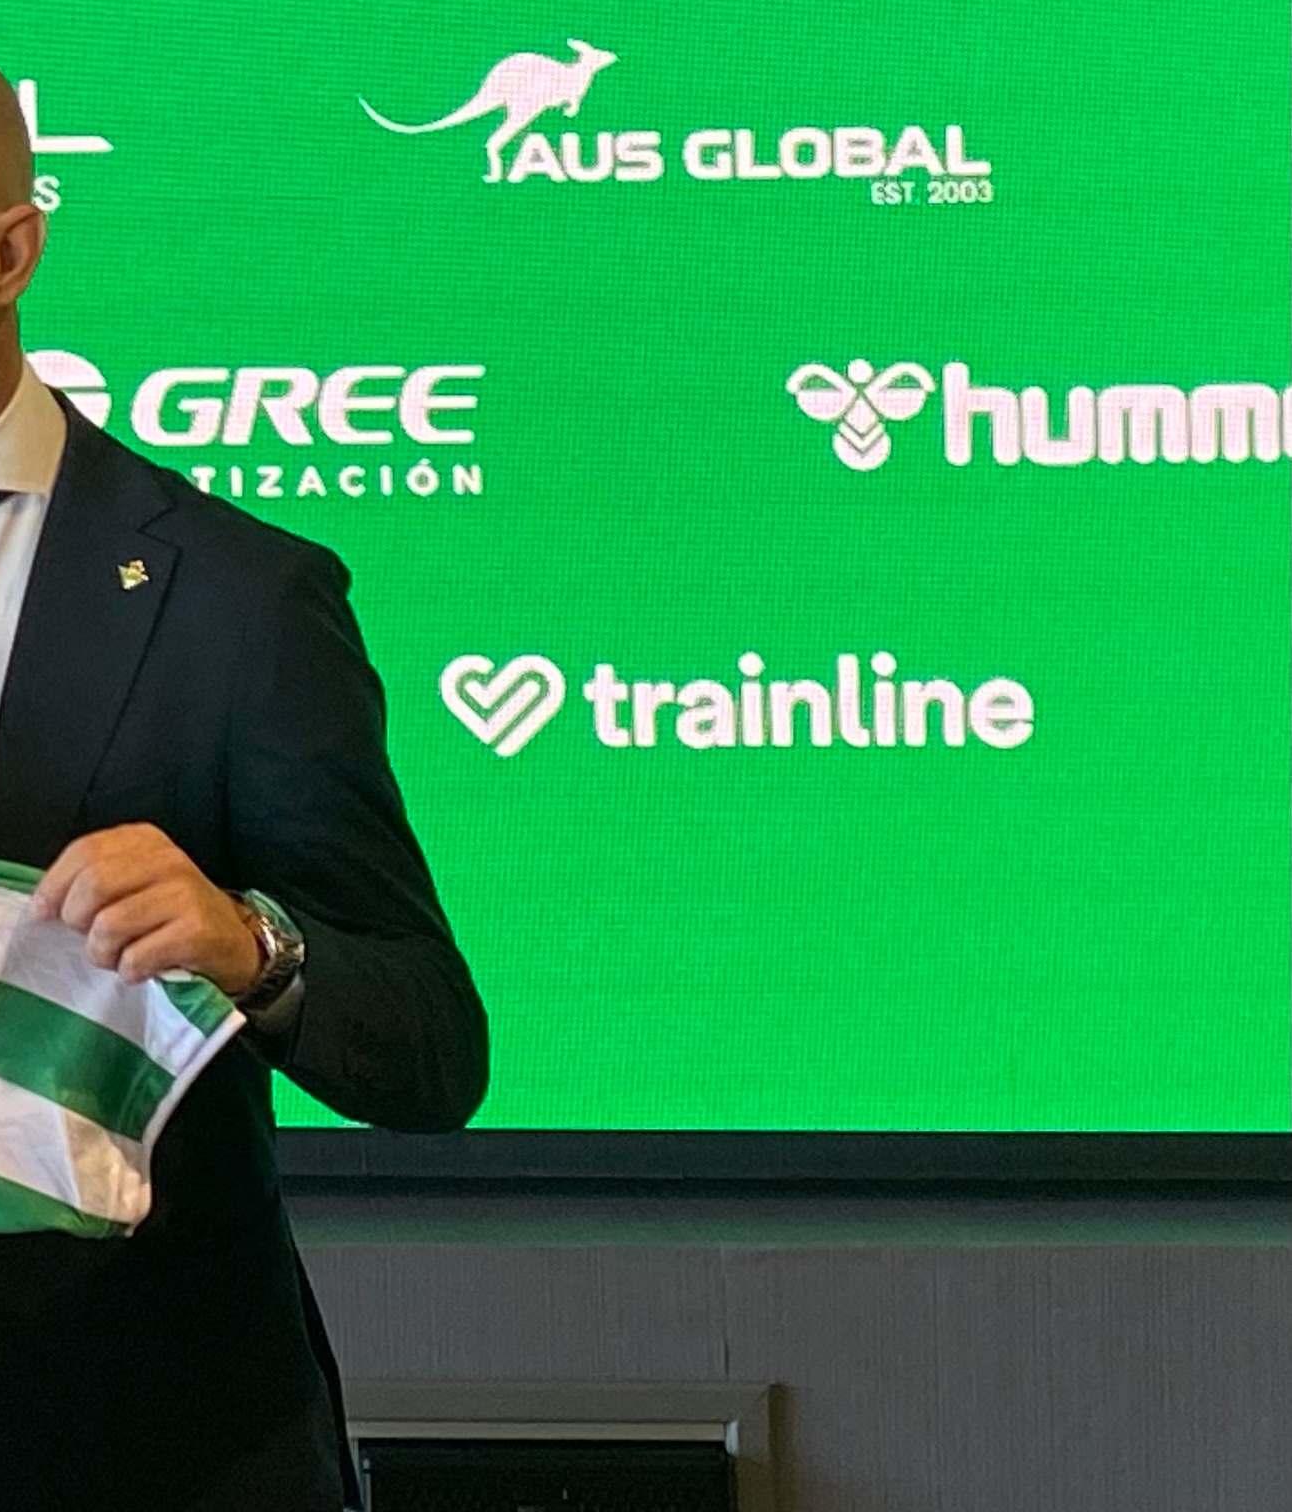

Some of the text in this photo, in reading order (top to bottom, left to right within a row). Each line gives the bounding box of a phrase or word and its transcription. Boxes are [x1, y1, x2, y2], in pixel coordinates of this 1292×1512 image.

[506, 125, 991, 182] AUS GLOBAL
[927, 181, 994, 204] 2003
[131, 365, 485, 446] GREE
[943, 362, 1292, 466] humm
[191, 459, 483, 498] TIZACIÓN
[584, 652, 1034, 749] trainline
